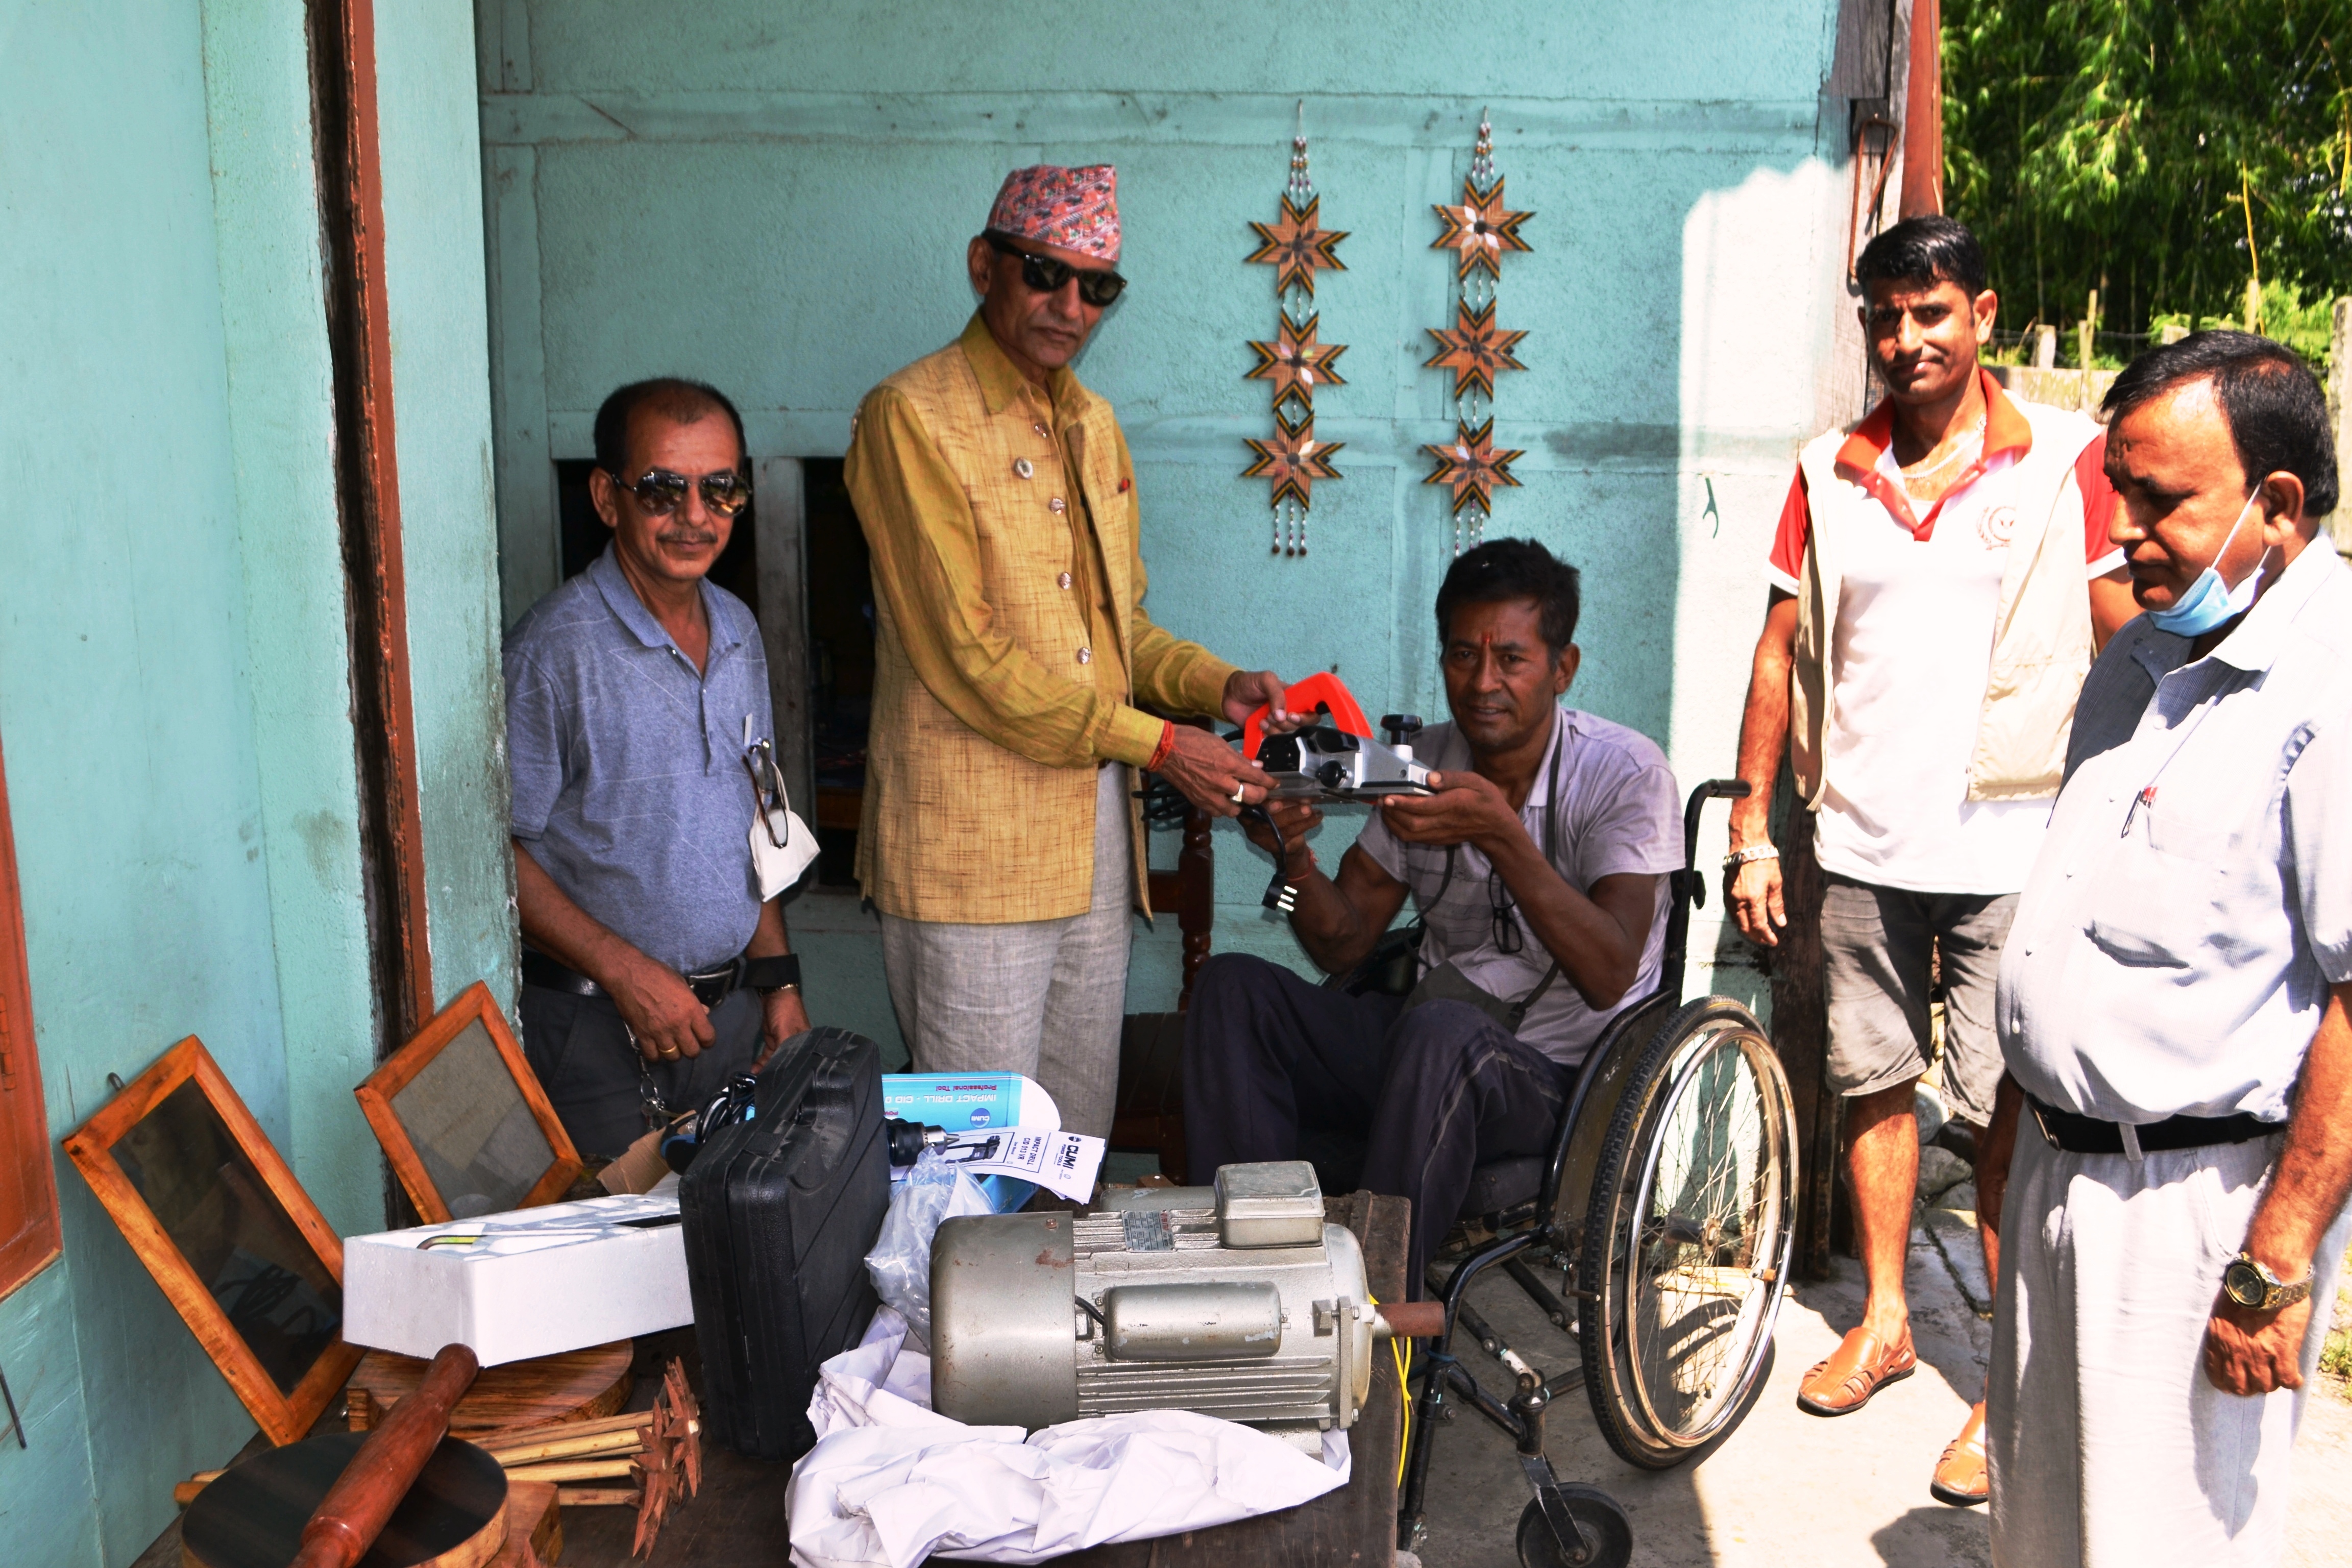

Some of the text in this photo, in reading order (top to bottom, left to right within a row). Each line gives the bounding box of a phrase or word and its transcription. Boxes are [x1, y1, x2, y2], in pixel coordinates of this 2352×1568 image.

[957, 1094, 996, 1102] IMPACT
[1026, 1136, 1042, 1165] IMPACT DRILL
[1062, 1145, 1079, 1169] CUMI
